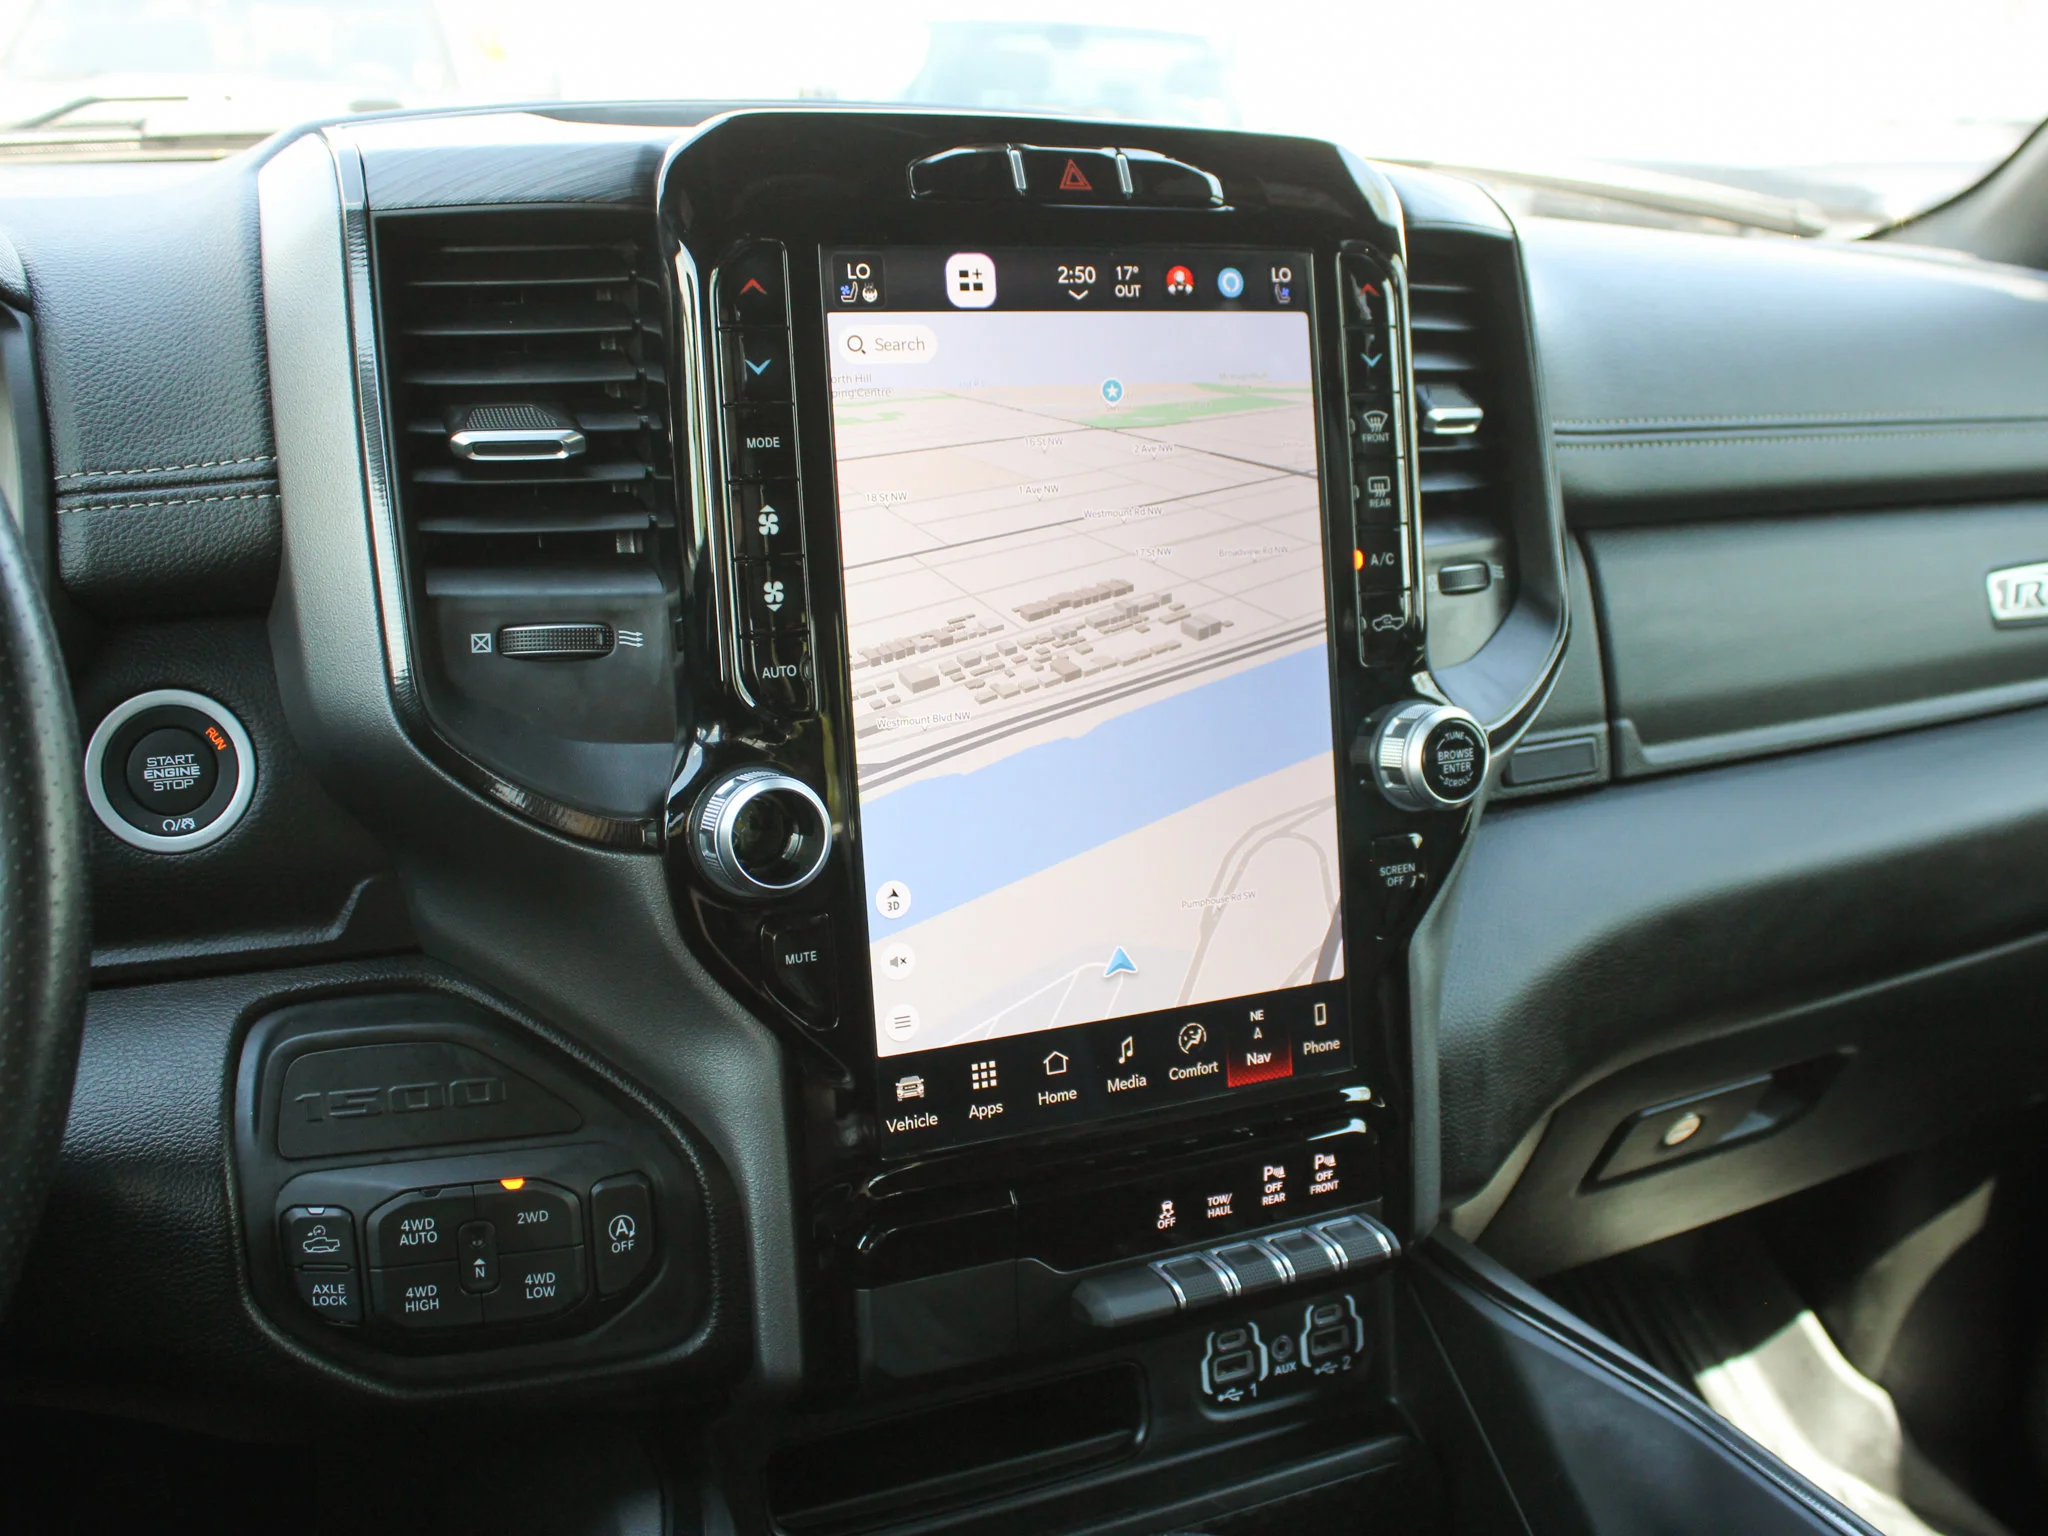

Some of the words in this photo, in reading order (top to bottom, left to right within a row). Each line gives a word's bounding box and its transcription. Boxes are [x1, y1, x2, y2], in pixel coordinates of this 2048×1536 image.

[847, 263, 870, 279] LO
[1057, 266, 1096, 284] 2:50
[1271, 267, 1292, 283] LO
[1115, 284, 1141, 298] OUT
[875, 337, 925, 352] Search
[855, 373, 872, 383] Hill
[856, 387, 892, 398] Centre
[746, 436, 781, 449] MODE
[1362, 432, 1390, 442] FRONT
[879, 493, 889, 502] St
[890, 491, 908, 501] NW
[1369, 498, 1392, 508] REAR
[1083, 507, 1133, 518] Westmount
[1134, 506, 1145, 516] Rd
[1370, 552, 1395, 566] A/C
[762, 664, 797, 679] AUTO
[877, 715, 931, 730] Westmount
[932, 712, 953, 724] Blvd
[954, 711, 971, 722] NW
[205, 726, 227, 751] RUN
[1445, 731, 1465, 741] TUNE
[147, 754, 195, 767] START
[1437, 747, 1474, 761] BROWSE
[144, 766, 200, 780] ENGINE
[1443, 762, 1472, 774] ENTER
[153, 779, 194, 792] STOP
[1443, 775, 1472, 787] SCROLL
[1379, 863, 1416, 877] SCREEN
[1387, 876, 1405, 888] OFF
[887, 901, 900, 911] 3D
[1181, 896, 1230, 909] Pumphouse
[1231, 893, 1242, 902] Rd
[785, 950, 818, 965] MUTE
[1250, 1009, 1264, 1022] NE
[1303, 1039, 1341, 1056] Phone
[1246, 1052, 1272, 1066] Nav
[1168, 1061, 1219, 1081] Comfort
[1107, 1074, 1147, 1093] Media
[295, 1077, 506, 1122] 1500
[1038, 1089, 1078, 1106] Home
[968, 1103, 1004, 1120] Apps
[886, 1112, 938, 1133] Vehicle
[1315, 1170, 1334, 1183] OFF
[1264, 1182, 1283, 1194] OFF
[1310, 1180, 1340, 1195] FRONT
[1207, 1193, 1233, 1206] TOW/
[1262, 1193, 1286, 1206] REAR
[517, 1210, 549, 1225] 2WD
[1207, 1206, 1233, 1219] HAUL
[401, 1217, 435, 1231] 4WD
[1157, 1217, 1176, 1230] OFF
[400, 1231, 438, 1246] AUTO
[611, 1240, 635, 1254] OFF
[475, 1266, 486, 1278] N
[524, 1272, 556, 1285] 4WD
[312, 1284, 345, 1294] AXLE
[405, 1285, 437, 1298] 4WD
[526, 1285, 556, 1300] LOW
[312, 1295, 348, 1307] LOCK
[405, 1298, 440, 1312] HIGH
[1274, 1361, 1297, 1376] AUX
[1342, 1355, 1352, 1371] 2
[1250, 1382, 1257, 1398] 1
